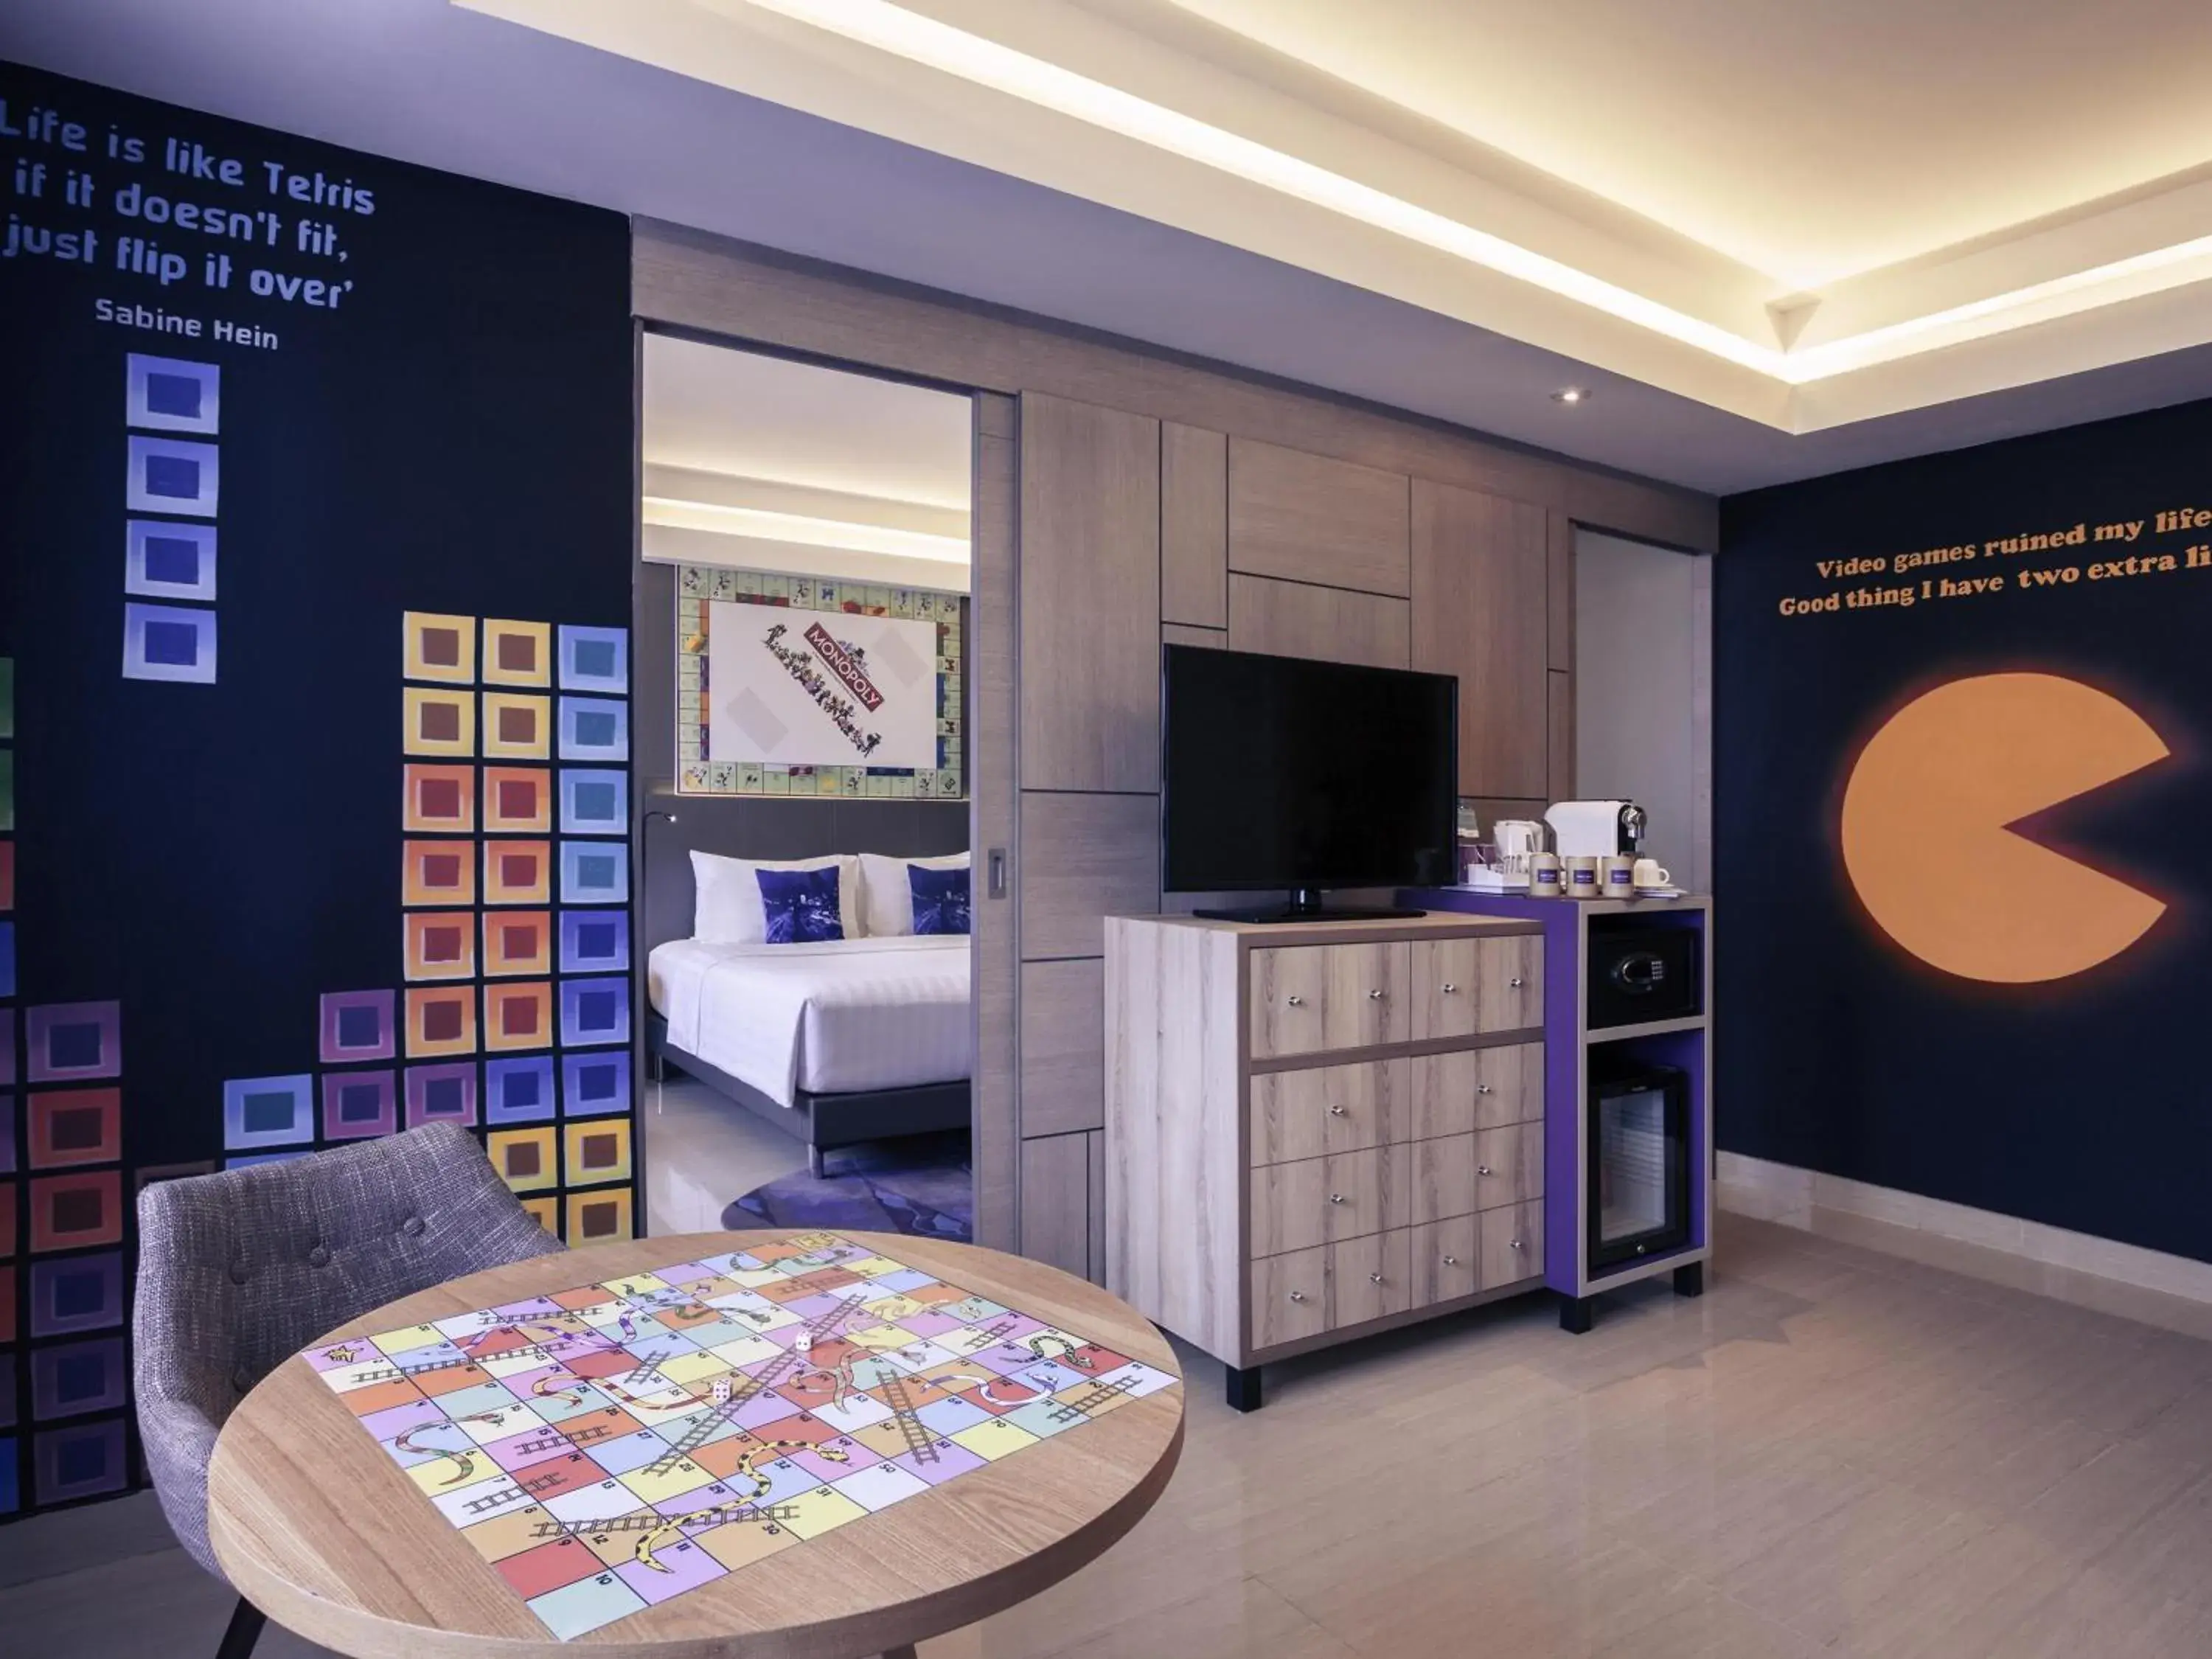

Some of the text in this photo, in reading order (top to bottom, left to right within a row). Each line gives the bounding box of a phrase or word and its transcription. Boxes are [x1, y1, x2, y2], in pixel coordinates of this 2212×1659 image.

[0, 98, 375, 215] Life is like Tetris
[15, 159, 347, 262] if it doesn't fit,
[3, 215, 98, 263] just
[117, 237, 187, 285] flip
[206, 254, 232, 288] it
[95, 299, 277, 349] Sabine Hein
[1817, 509, 2212, 577] Video games ruined my life
[1780, 593, 1840, 615] Good
[1846, 588, 1914, 608] thing
[1922, 581, 1931, 599] I
[1940, 577, 2003, 597] have
[2019, 568, 2079, 588] two
[2088, 555, 2177, 580] extra
[810, 630, 880, 704] MONOPOLY
[816, 1487, 832, 1498] 31
[592, 1534, 608, 1545] 12
[762, 1523, 780, 1536] 30
[596, 1573, 612, 1585] 10
